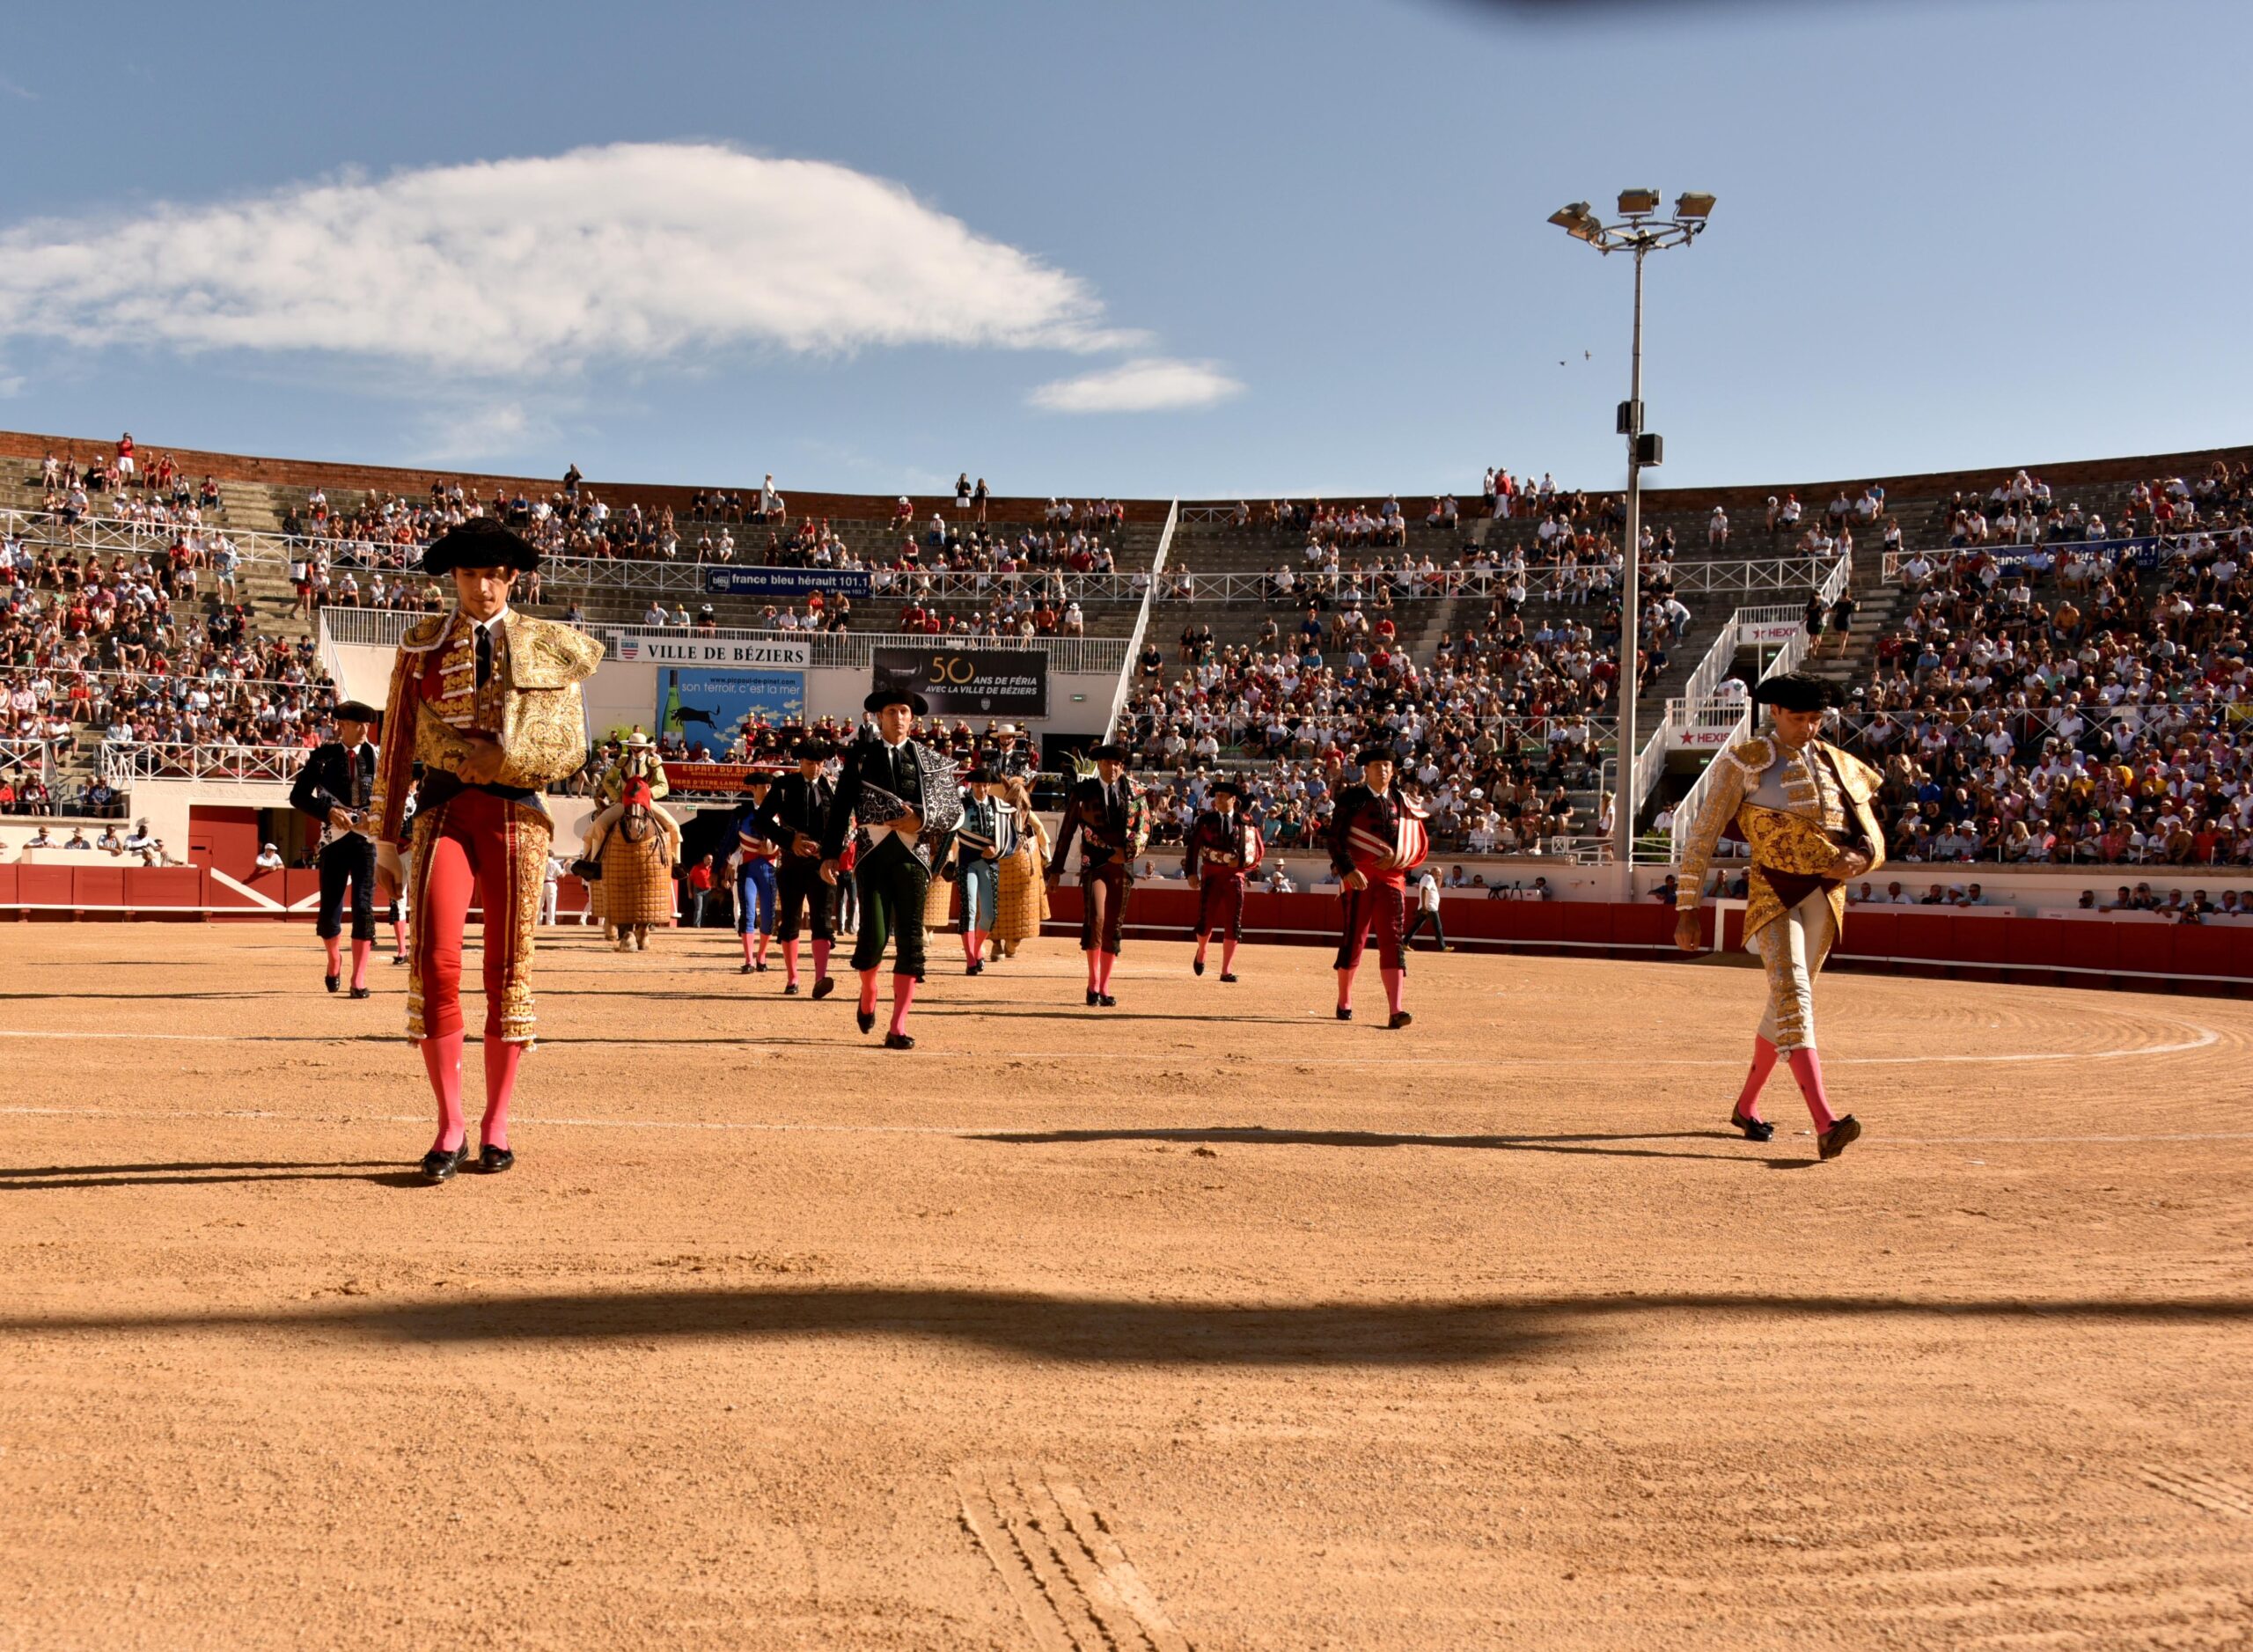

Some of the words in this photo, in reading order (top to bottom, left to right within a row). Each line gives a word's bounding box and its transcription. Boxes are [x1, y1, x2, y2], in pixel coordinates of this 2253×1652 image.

[2128, 544, 2156, 557] 01.1
[732, 573, 767, 584] france
[771, 574, 794, 585] bleu
[798, 575, 836, 587] hérault
[840, 576, 868, 587] 101.1
[648, 644, 697, 659] VILLE
[704, 647, 726, 660] DE
[734, 645, 804, 663] BÉZIERS
[929, 657, 974, 684] 50
[1009, 675, 1037, 686] FÉRIA
[704, 682, 737, 694] terroir,
[739, 683, 764, 694] c'est
[767, 684, 777, 694] la
[780, 686, 800, 695] mer
[925, 685, 947, 694] AVEC
[961, 686, 984, 694] VILLE
[1000, 686, 1037, 695] BÉZIERS
